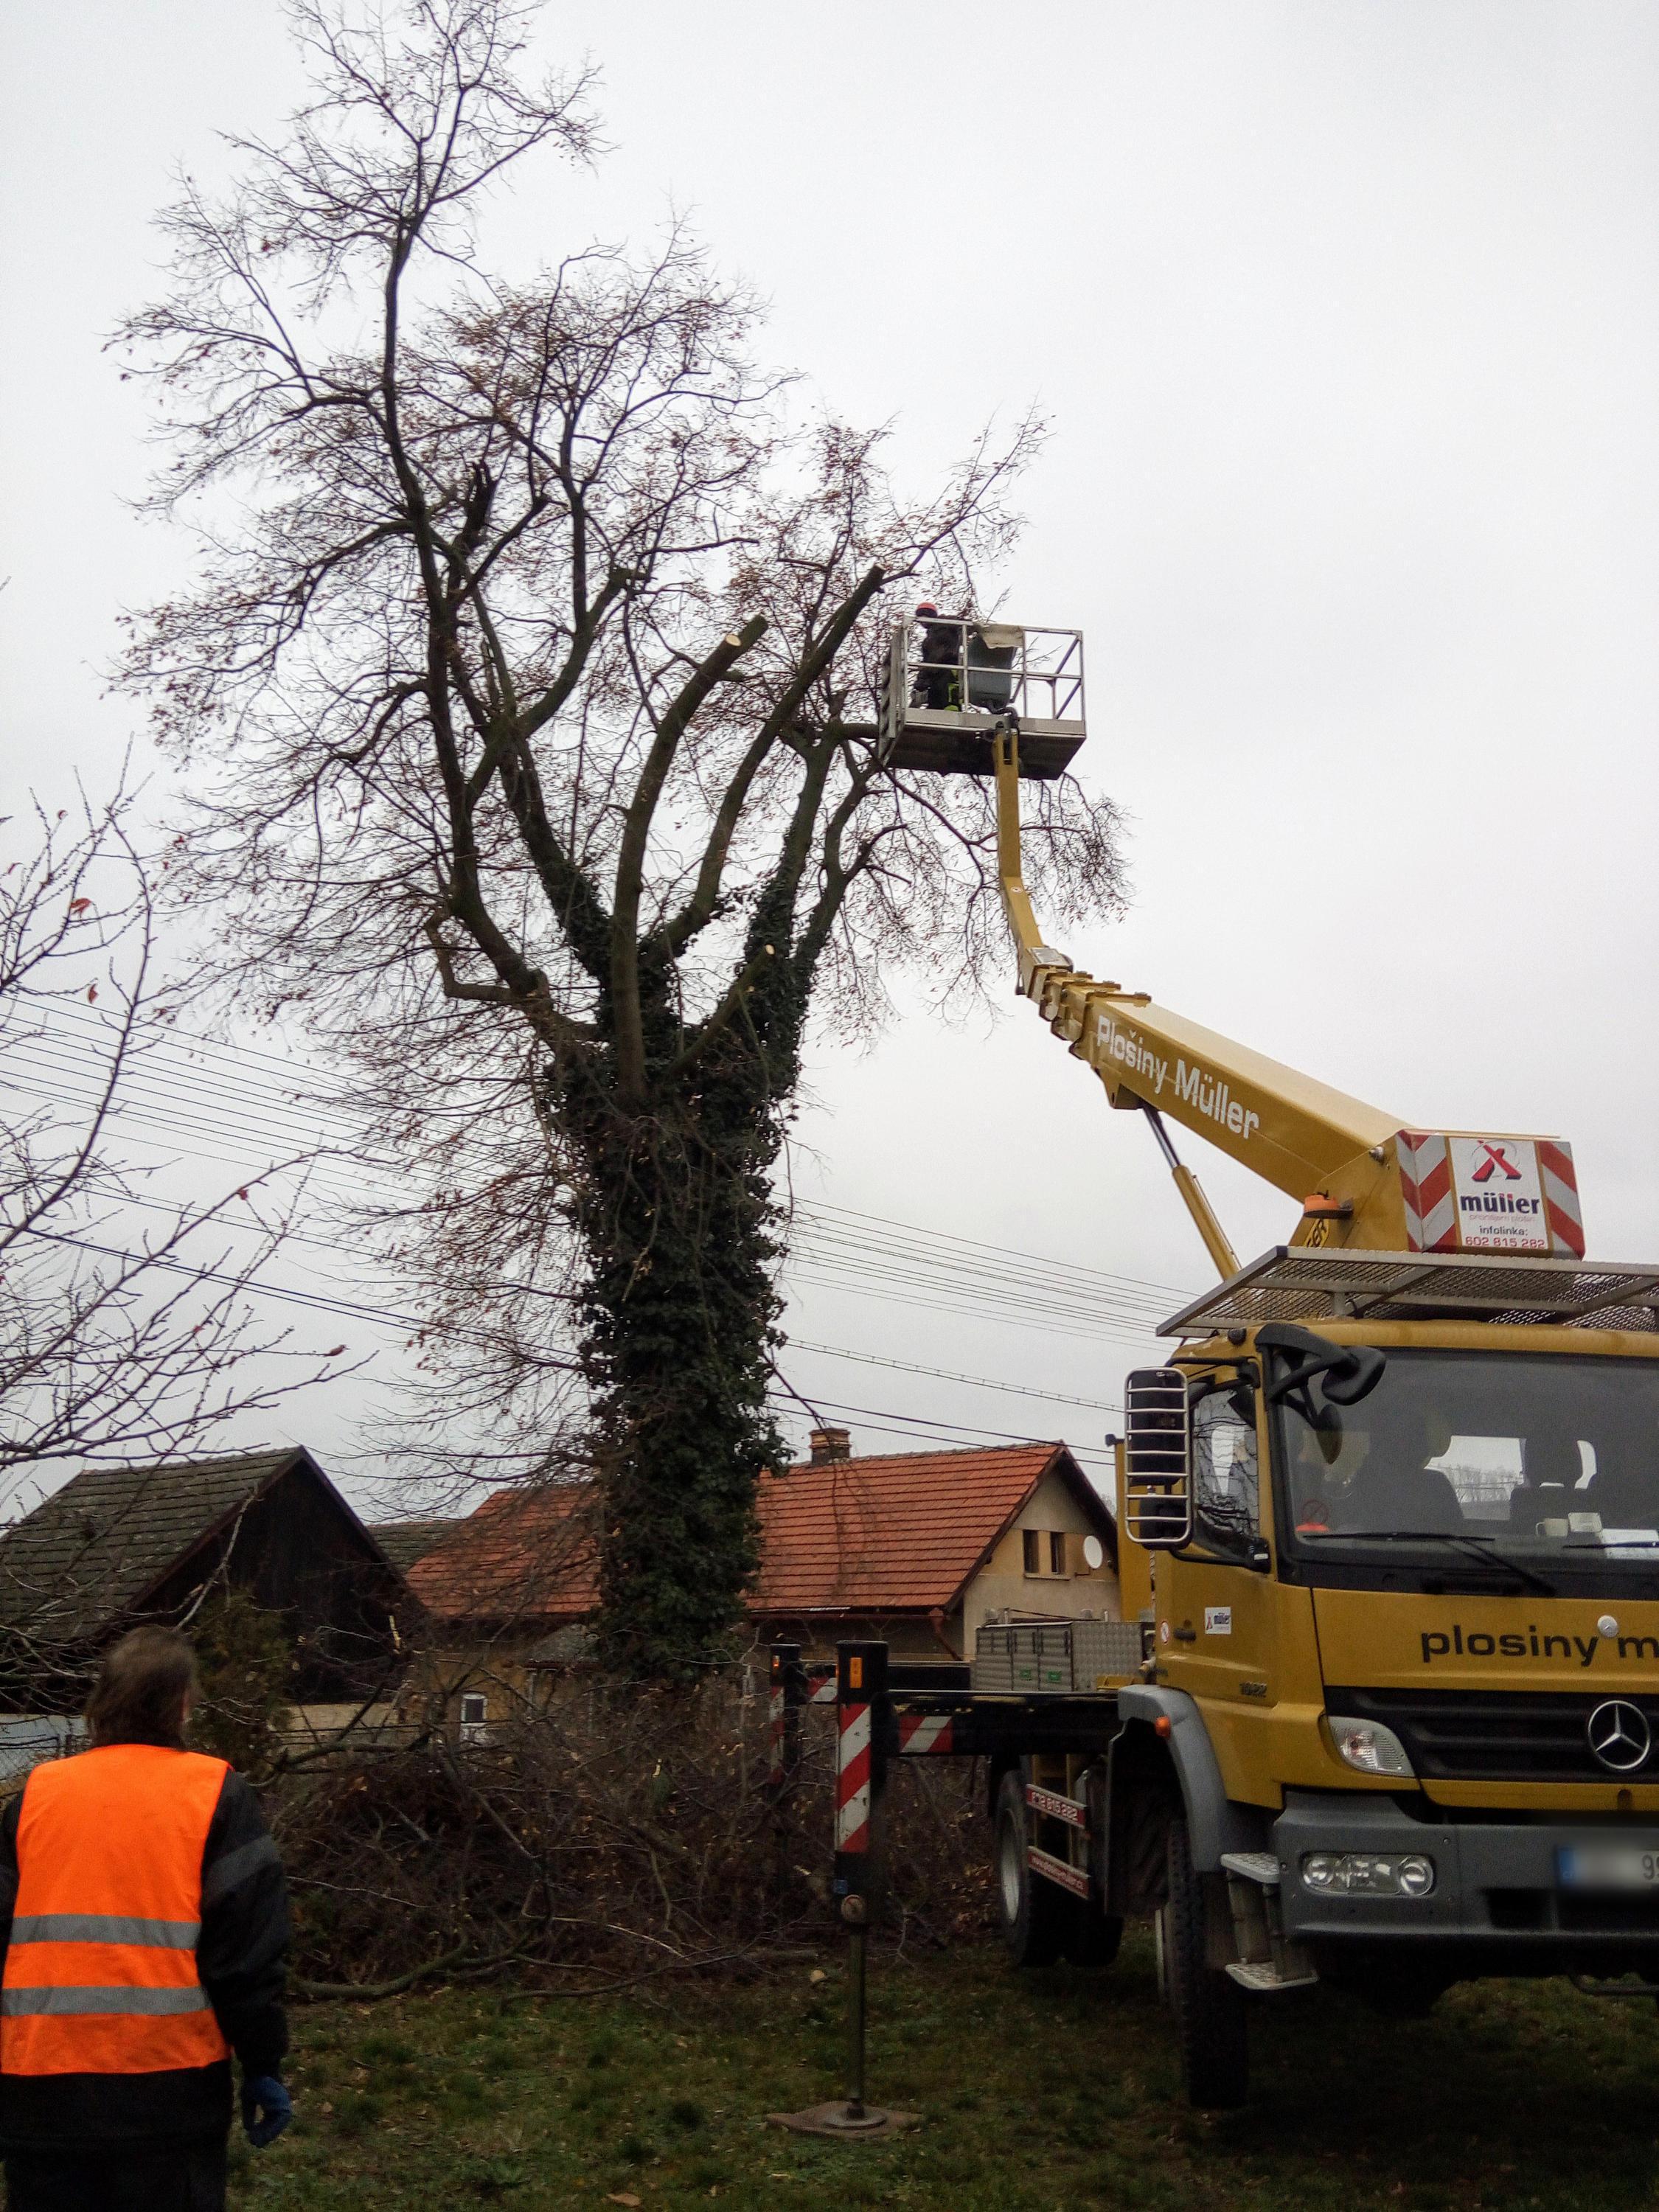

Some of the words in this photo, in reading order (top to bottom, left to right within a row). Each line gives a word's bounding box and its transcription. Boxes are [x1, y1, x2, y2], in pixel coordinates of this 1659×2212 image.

[1097, 1015, 1167, 1094] Plošiny
[1175, 1059, 1259, 1139] Müller
[1461, 1192, 1540, 1214] müller
[1479, 1225, 1528, 1236] infolinka:
[1465, 1237, 1489, 1246] 602
[1493, 1237, 1517, 1248] 815
[1521, 1239, 1545, 1249] 282
[1422, 1624, 1598, 1666] plosiny
